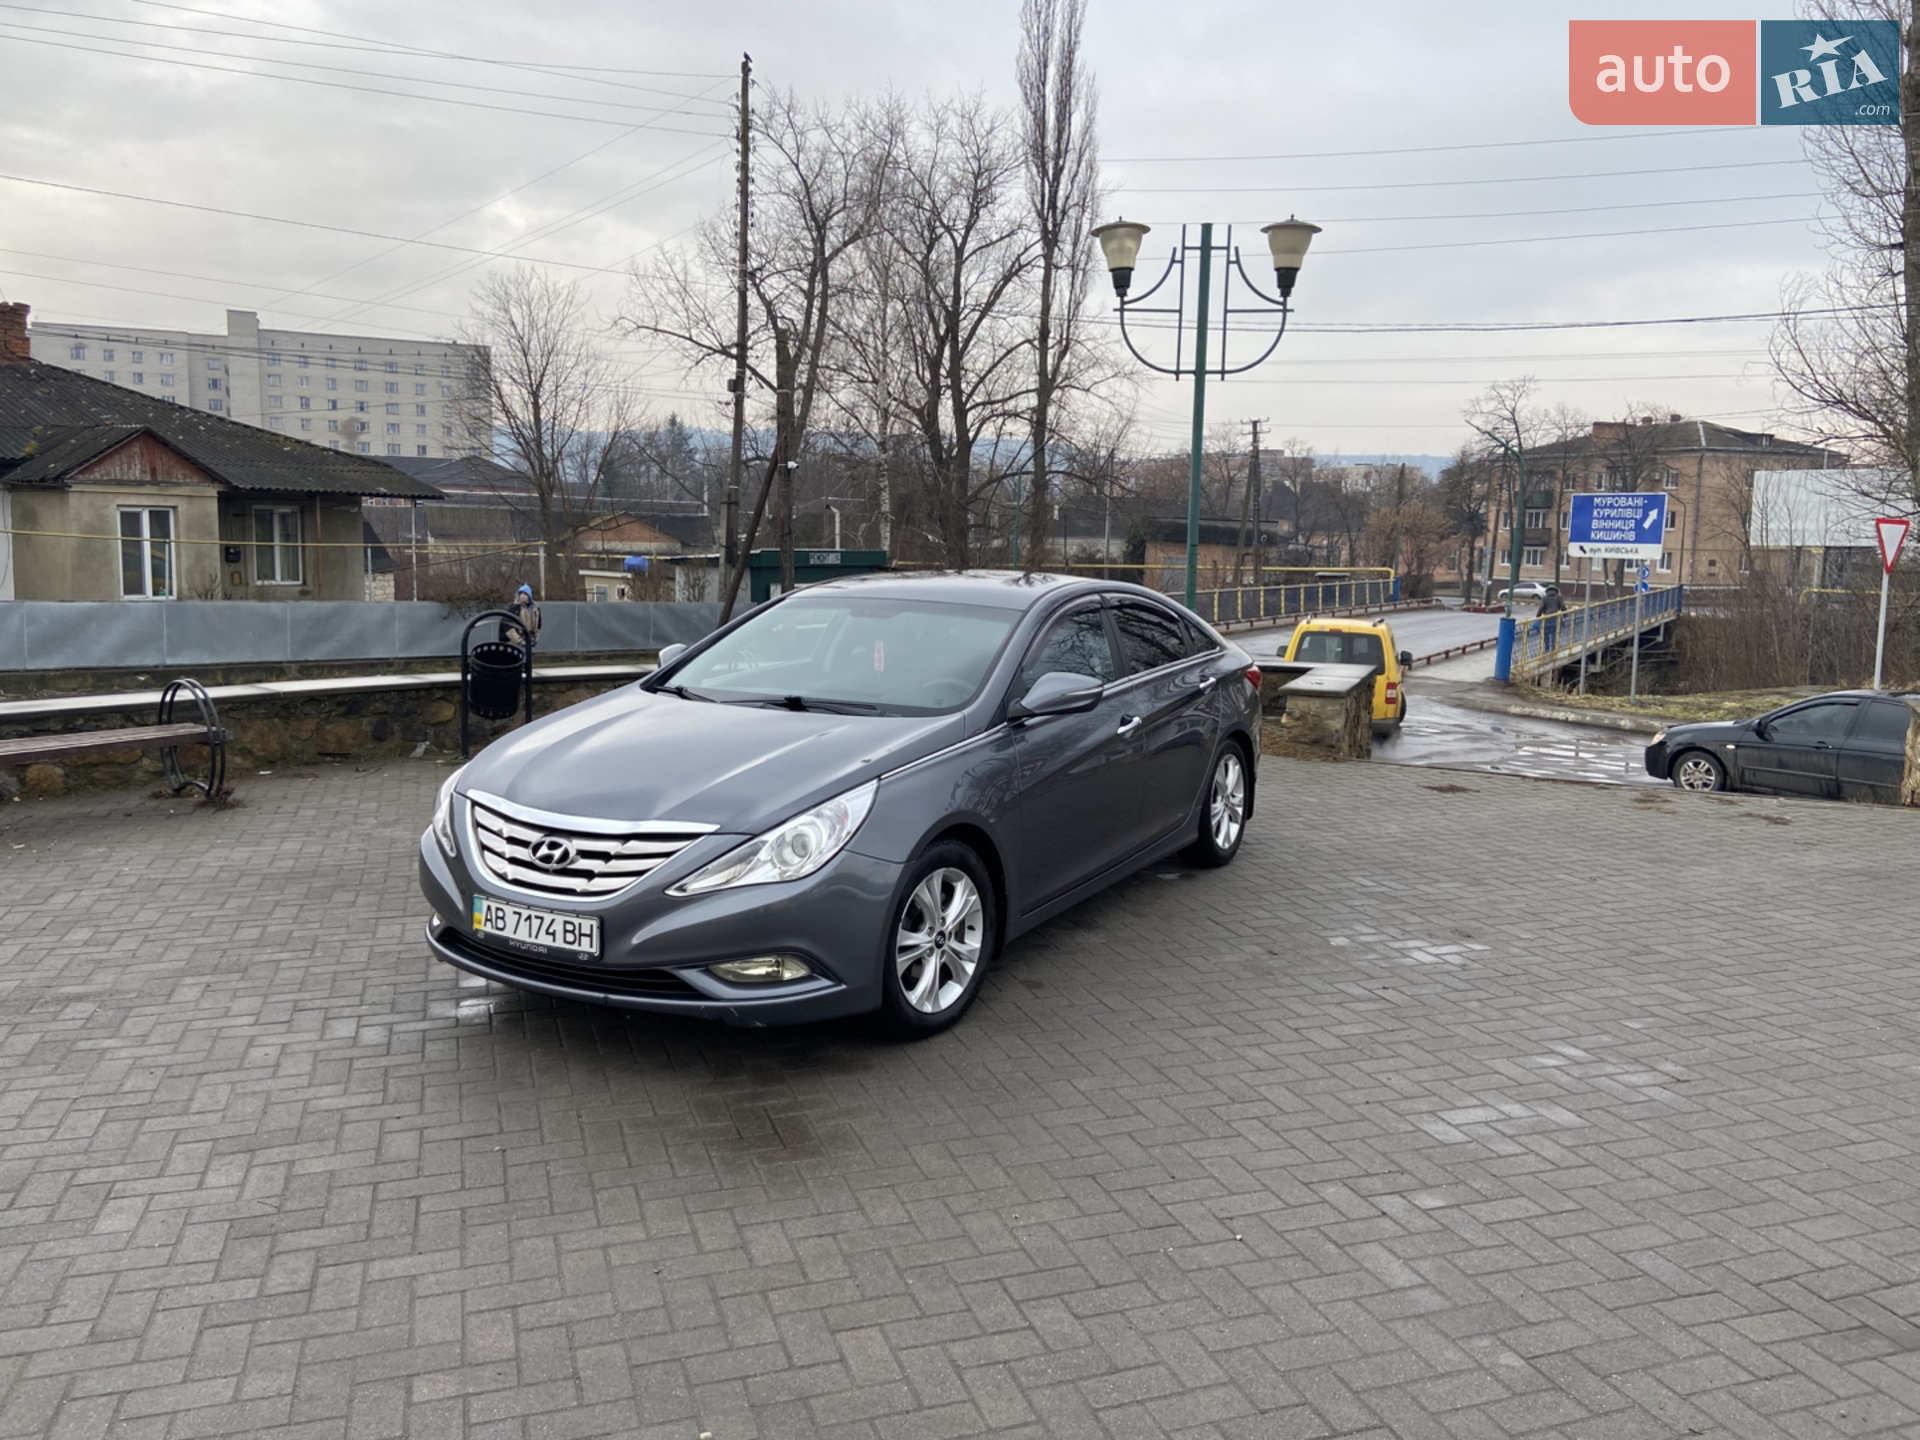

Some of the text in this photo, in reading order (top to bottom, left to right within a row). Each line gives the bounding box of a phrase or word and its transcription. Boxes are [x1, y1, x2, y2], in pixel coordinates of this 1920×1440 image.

[1592, 508, 1644, 520] КУРИЛІВЦІ
[1591, 519, 1636, 531] ВІННИЦЯ
[1590, 530, 1636, 541] КИШИНІВ
[484, 904, 594, 949] AB 7174 BH
[508, 939, 548, 954] HYUNDAI
